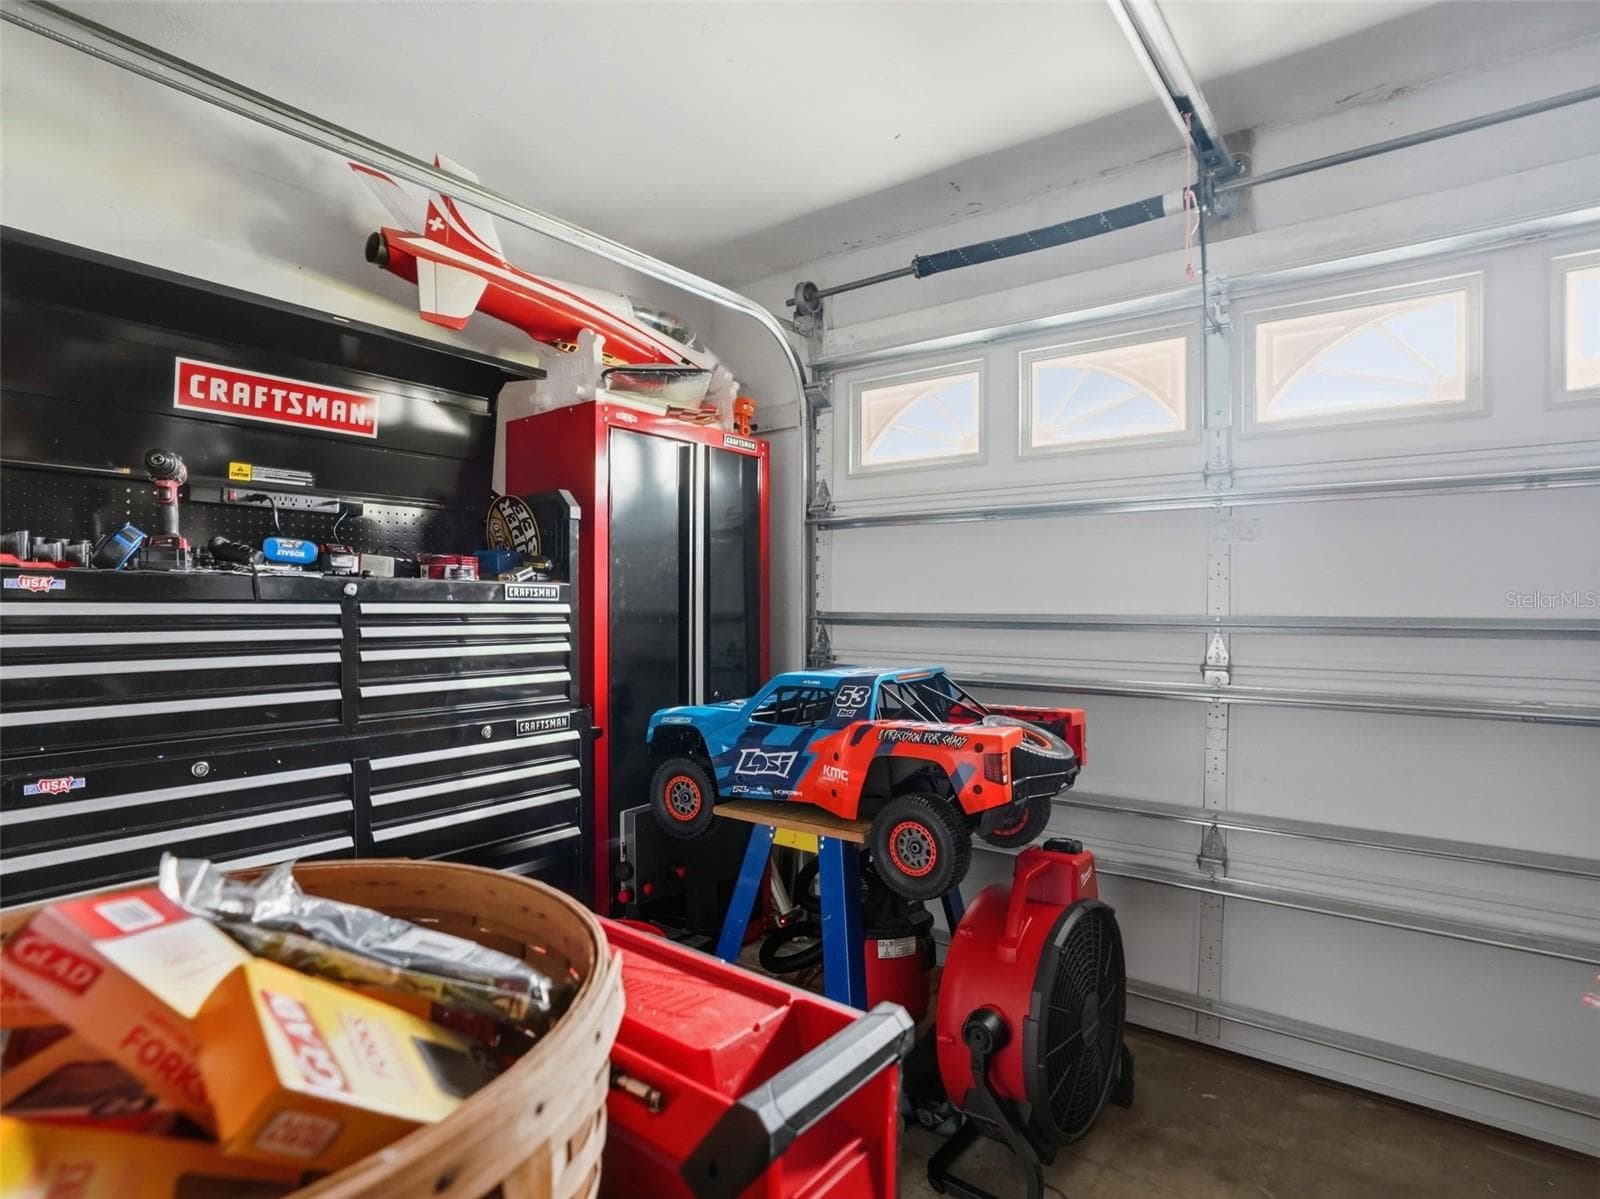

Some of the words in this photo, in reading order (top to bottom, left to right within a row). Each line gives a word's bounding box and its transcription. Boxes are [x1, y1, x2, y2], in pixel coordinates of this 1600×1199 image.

[189, 374, 369, 426] CRAFTSMAN
[21, 577, 49, 588] USA
[508, 586, 557, 599] CRAFTSMAN
[835, 685, 871, 707] 53
[520, 717, 568, 732] CRAFTSMAN
[41, 780, 69, 791] USA
[13, 933, 95, 986] GLAD
